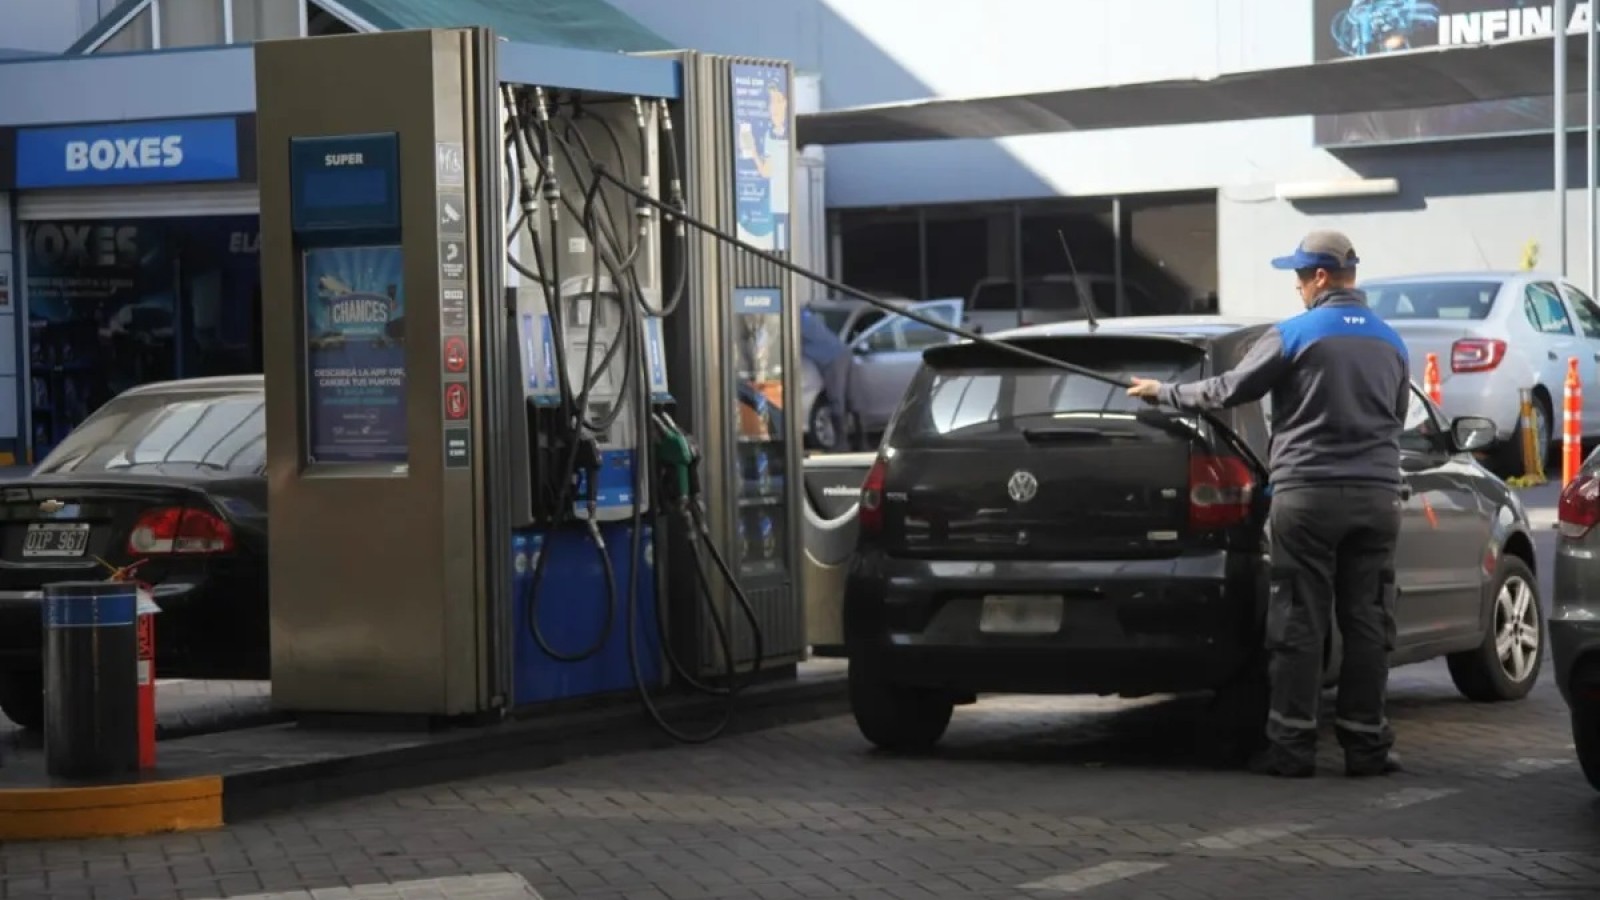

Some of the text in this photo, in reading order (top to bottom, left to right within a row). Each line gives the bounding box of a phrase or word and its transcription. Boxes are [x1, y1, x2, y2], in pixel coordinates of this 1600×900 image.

[1438, 3, 1600, 45] INFINA
[65, 135, 183, 171] BOXES
[325, 153, 363, 166] SUPER
[27, 222, 138, 266] OXES
[333, 299, 387, 322] CHANCES
[1343, 316, 1366, 325] YPF
[57, 531, 85, 549] 967
